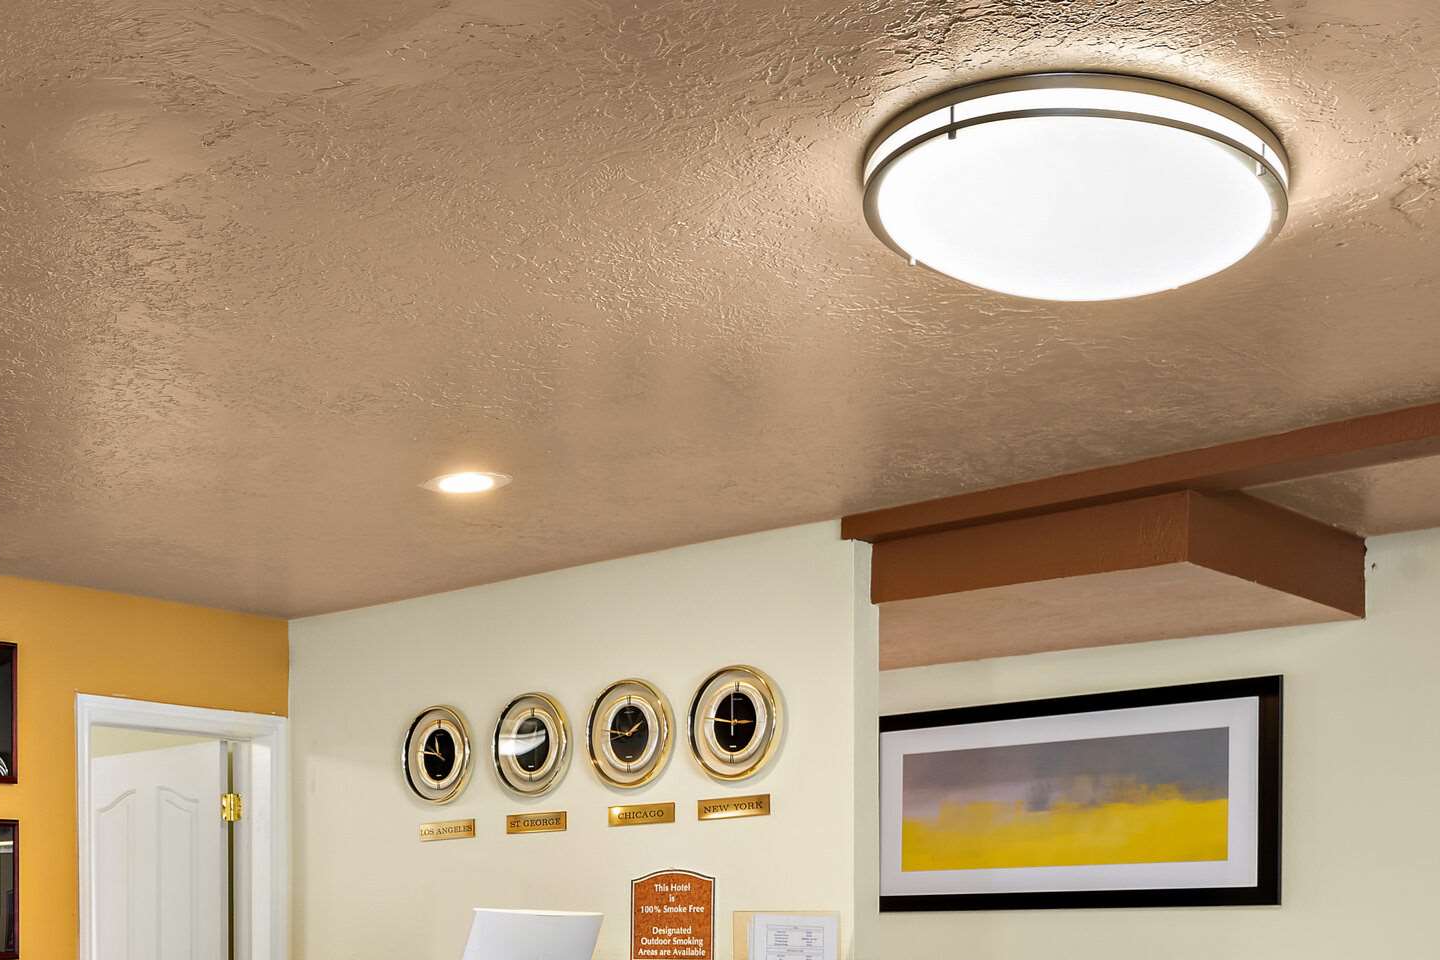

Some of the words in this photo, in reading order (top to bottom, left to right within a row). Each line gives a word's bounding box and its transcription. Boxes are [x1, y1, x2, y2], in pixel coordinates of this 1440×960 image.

[703, 804, 730, 815] NEW
[733, 800, 763, 811] YORK
[617, 808, 665, 821] CHICAGO
[522, 817, 561, 828] GEORGE
[420, 827, 435, 837] LOS
[435, 824, 473, 836] ANGELES
[655, 882, 669, 892] This
[670, 882, 692, 892] Hotel
[668, 893, 676, 903] is
[640, 905, 661, 914] 100%
[663, 904, 688, 914] Smoke
[688, 904, 705, 914] Free
[651, 925, 692, 937] Designated
[640, 937, 671, 946] Outdoor
[672, 936, 704, 948] Smoking
[637, 947, 658, 957] Areas
[659, 949, 671, 957] are
[672, 947, 706, 957] Available
